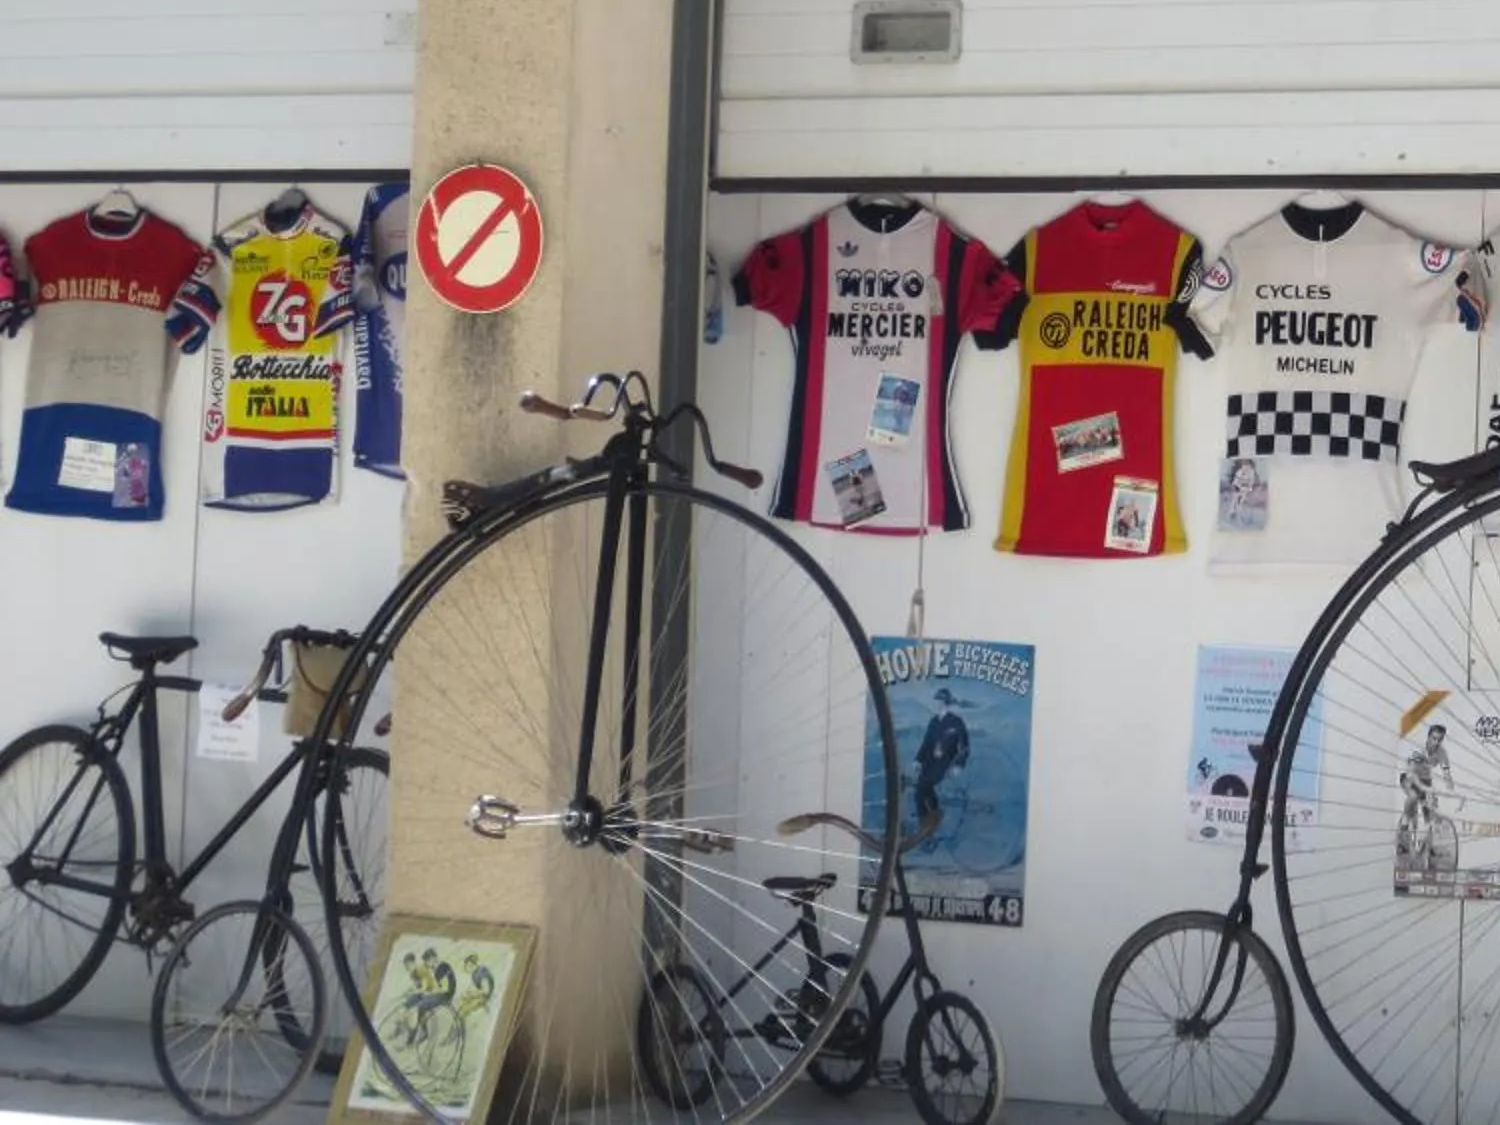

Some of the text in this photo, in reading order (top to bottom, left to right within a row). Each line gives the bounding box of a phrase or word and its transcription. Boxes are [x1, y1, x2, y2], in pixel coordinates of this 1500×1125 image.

[835, 269, 924, 297] MIKO
[1255, 284, 1331, 300] CYCLES
[828, 313, 925, 339] MERCIER
[1073, 299, 1161, 332] RALEIGH
[1255, 310, 1378, 348] PEUGEOT
[1081, 331, 1149, 360] CREDA
[1276, 356, 1354, 375] MICHELIN
[246, 396, 310, 418] ITALIA
[955, 642, 1029, 676] BICYCLES
